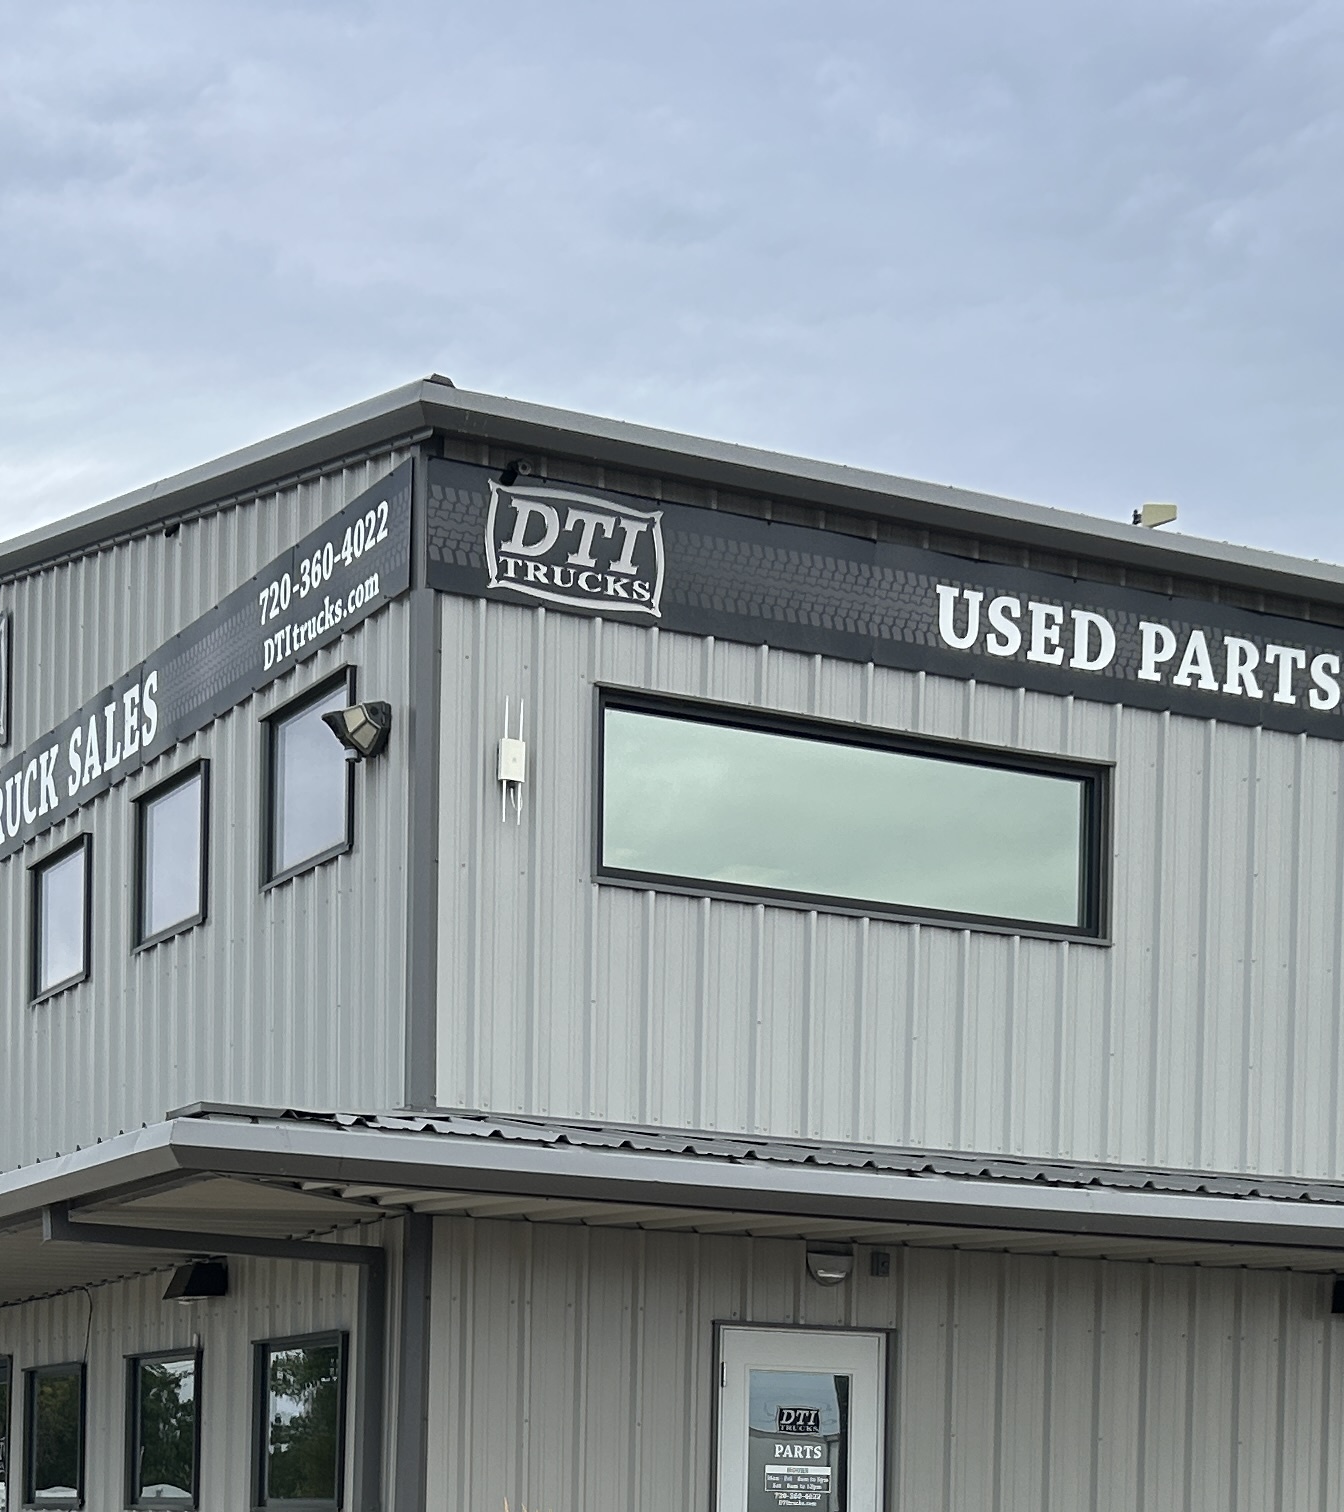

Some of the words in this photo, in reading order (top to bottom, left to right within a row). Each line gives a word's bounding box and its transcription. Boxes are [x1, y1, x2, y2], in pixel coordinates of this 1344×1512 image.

[259, 501, 389, 625] 720-360-4022
[498, 496, 650, 575] DTI
[499, 556, 651, 601] TRUCKS
[263, 572, 380, 671] DTItrucks.com
[936, 584, 1116, 671] USED
[1138, 621, 1341, 711] PARTS
[68, 670, 158, 797] SALES
[774, 1444, 822, 1458] PARTS
[780, 1409, 818, 1425] DTI
